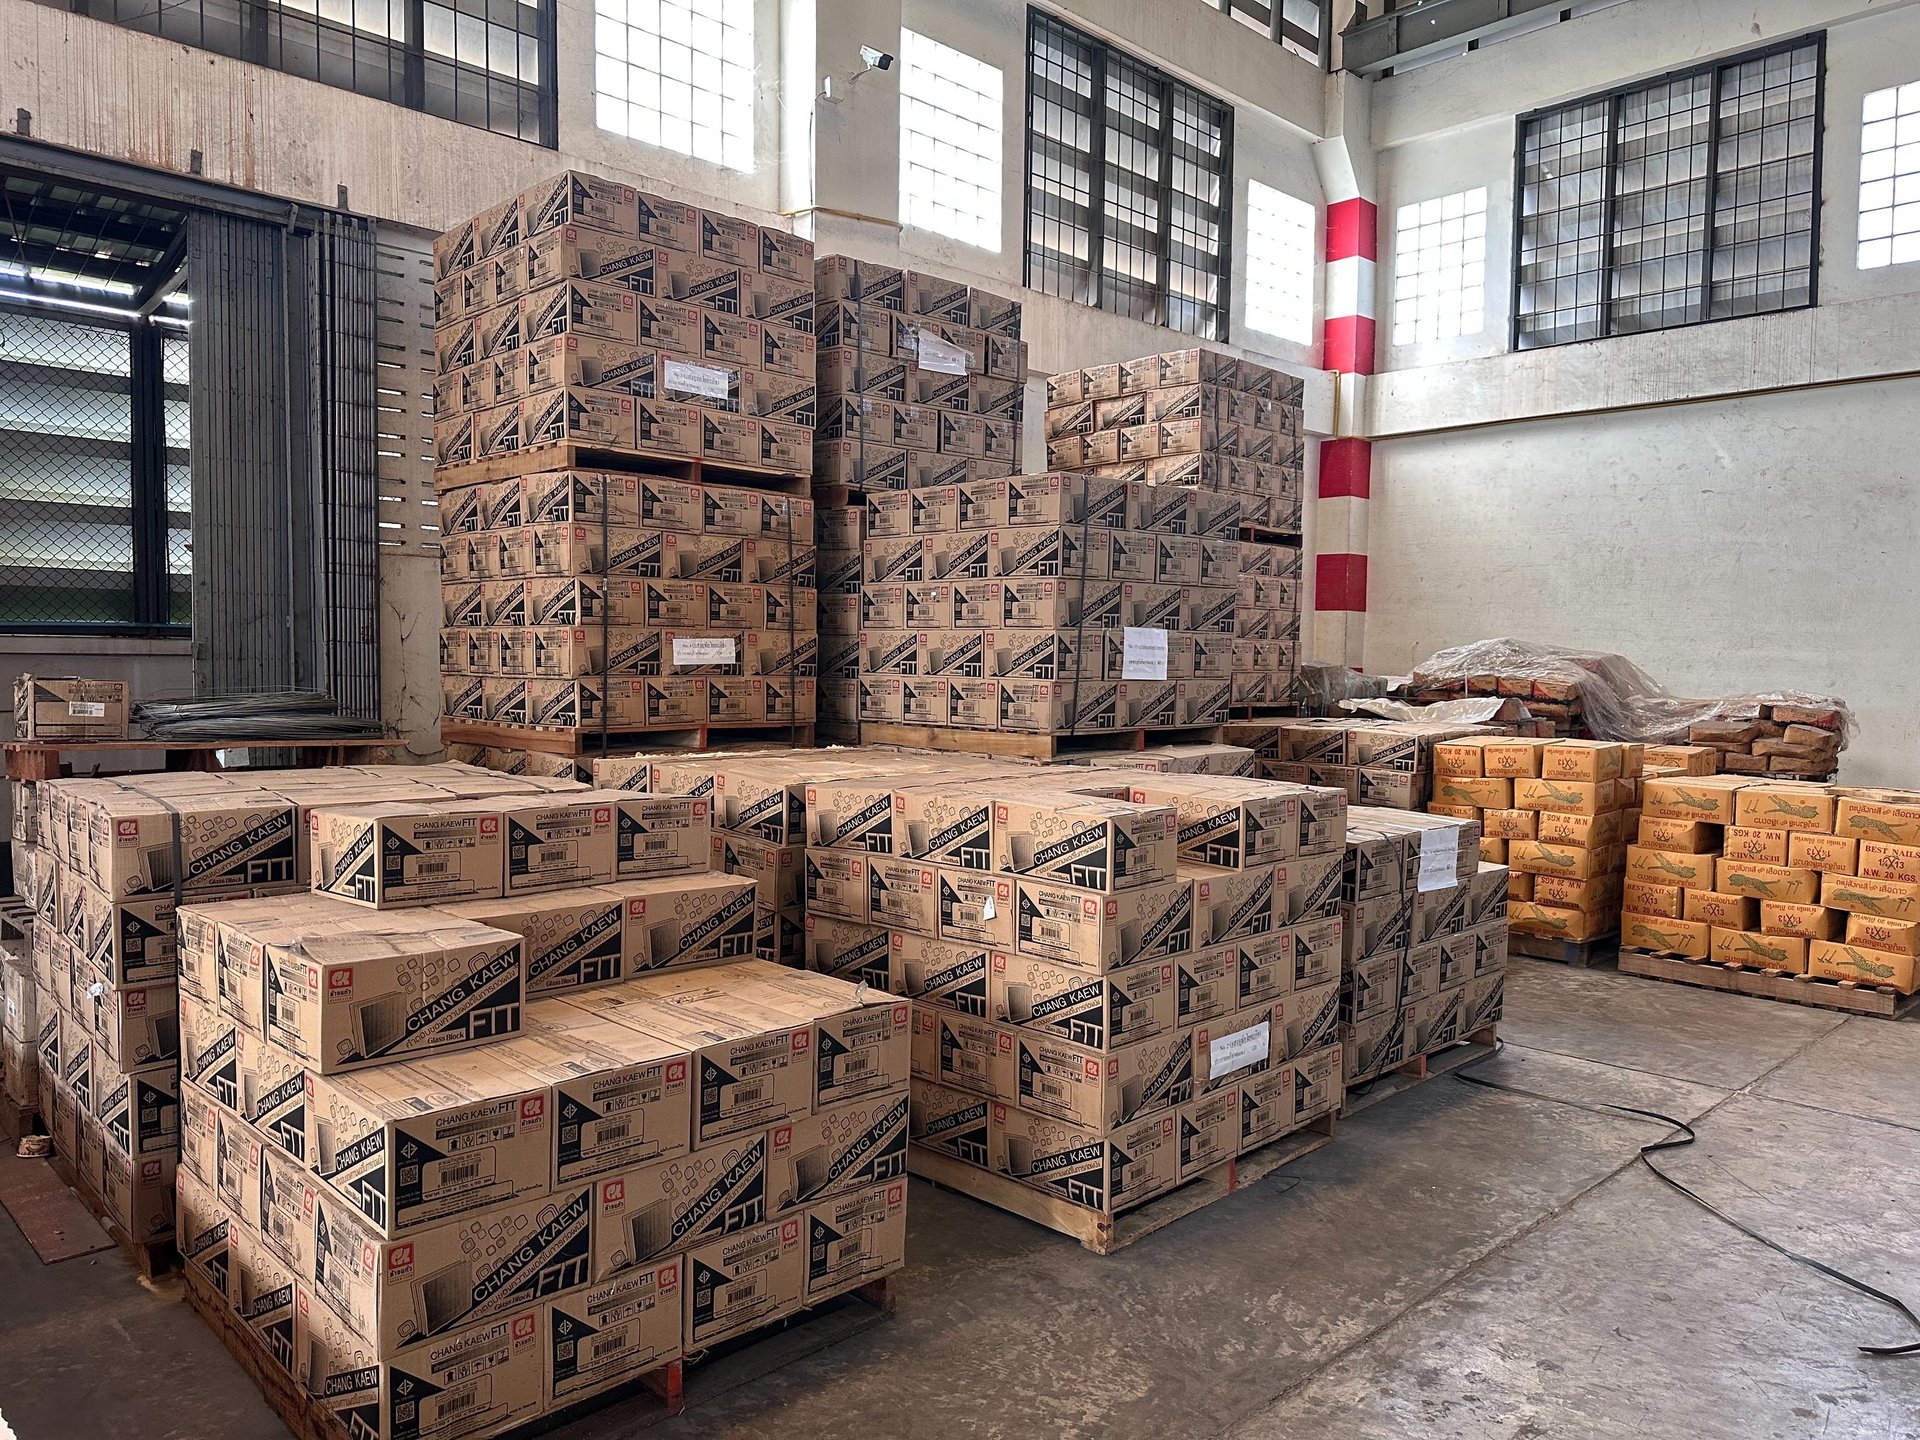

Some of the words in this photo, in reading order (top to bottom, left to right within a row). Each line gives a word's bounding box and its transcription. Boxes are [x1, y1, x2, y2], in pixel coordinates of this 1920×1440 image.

[600, 259, 628, 275] CHANG
[629, 252, 652, 266] KAEW
[629, 275, 653, 295] FIT
[689, 281, 714, 296] CHANG
[715, 273, 736, 287] KAEW
[715, 296, 737, 314] FIT
[770, 301, 793, 315] CHANG
[794, 294, 813, 307] KAEW
[793, 315, 813, 333] FIT
[602, 366, 630, 381] CHANG
[630, 356, 652, 370] KAEW
[772, 397, 795, 411] CHANG
[795, 390, 814, 402] KAEW
[795, 410, 815, 427] FIT
[611, 550, 638, 566] CHANG
[638, 536, 660, 552] KAEW
[949, 553, 969, 570] CHANG
[970, 539, 986, 554] KAEW
[1016, 550, 1038, 567] CHANG
[1038, 535, 1058, 551] KAEW
[638, 562, 661, 577] FIT
[969, 564, 988, 578] FIT
[1038, 561, 1058, 576] FIT
[1011, 652, 1033, 669] CHANG
[1034, 638, 1053, 653] KAEW
[1033, 664, 1054, 679] FIT
[1452, 748, 1461, 756] 20
[738, 807, 759, 823] CHANG
[760, 794, 781, 812] KAEW
[837, 817, 864, 837] CHANG
[865, 799, 889, 819] KAEW
[1430, 805, 1445, 813] BEST
[1447, 807, 1468, 815] NAILS
[1563, 814, 1571, 824] 20
[413, 821, 440, 830] CHANG
[440, 819, 461, 828] KAEW
[462, 818, 477, 827] FIT
[760, 824, 783, 845] FIT
[930, 830, 958, 850] CHANG
[960, 811, 986, 832] KAEW
[1751, 830, 1761, 839] 20
[190, 840, 243, 875] CHANG
[246, 814, 288, 843] KAEW
[335, 852, 354, 878] CHANG
[354, 829, 373, 854] KAEW
[865, 833, 892, 853] FIT
[1035, 844, 1069, 865] CHANG
[1072, 826, 1104, 848] KAEW
[1207, 843, 1239, 868] FIT
[1730, 851, 1754, 860] NAILS
[1865, 845, 1889, 855] BEST
[1892, 848, 1920, 858] NAILS
[248, 857, 293, 882] FIT
[960, 847, 990, 870] FIT
[1757, 854, 1781, 863] BEST
[356, 875, 375, 902] FIT
[1071, 864, 1106, 890] FIT
[1863, 868, 1880, 877] N.W.
[1885, 871, 1894, 880] 20
[1898, 874, 1918, 884] KGS.
[1626, 883, 1645, 892] BEST
[1648, 887, 1671, 896] NAILS
[680, 916, 719, 950] CHANG
[721, 893, 753, 918] KAEW
[1141, 917, 1169, 947] CHANG
[1170, 890, 1191, 918] KAEW
[1251, 912, 1271, 933] FIT
[1642, 906, 1650, 914] 20
[530, 939, 577, 976] CHANG
[581, 909, 618, 944] KAEW
[719, 932, 753, 958] FIT
[1168, 930, 1191, 953] FIT
[580, 954, 622, 984] FIT
[925, 971, 954, 991] CHANG
[956, 958, 983, 978] KAEW
[407, 989, 466, 1031] CHANG
[469, 951, 517, 989] KAEW
[1032, 997, 1067, 1018] CHANG
[1069, 985, 1100, 1004] KAEW
[956, 993, 986, 1018] FIT
[469, 1003, 519, 1040] FIT
[1069, 1018, 1102, 1049] FIT
[428, 1034, 445, 1044] Glass
[446, 1031, 465, 1041] Block
[730, 1044, 755, 1055] CHANG
[755, 1039, 776, 1051] KAEW
[776, 1034, 789, 1045] FIT
[593, 1076, 621, 1089] CHANG
[622, 1072, 646, 1084] KAEW
[646, 1065, 662, 1078] FIT
[257, 1091, 280, 1116] CHANG
[280, 1076, 303, 1099] KAEW
[436, 1112, 469, 1127] CHANG
[470, 1107, 498, 1120] KAEW
[498, 1100, 517, 1114] FIT
[926, 1117, 955, 1135] CHANG
[957, 1106, 984, 1123] KAEW
[280, 1121, 304, 1161] FIT
[335, 1148, 359, 1171] CHANG
[360, 1132, 383, 1157] KAEW
[829, 1138, 871, 1179] CHANG
[873, 1102, 907, 1139] KAEW
[957, 1137, 987, 1166] FIT
[872, 1149, 907, 1183] FIT
[1031, 1153, 1067, 1173] CHANG
[1069, 1145, 1100, 1162] KAEW
[672, 1187, 722, 1237] CHANG
[724, 1146, 763, 1187] KAEW
[1068, 1178, 1102, 1210] FIT
[362, 1180, 385, 1230] FIT
[723, 1196, 766, 1235] FIT
[474, 1246, 535, 1301] CHANG
[538, 1199, 584, 1246] KAEW
[536, 1253, 588, 1298] FIT
[431, 1342, 463, 1360] CHANG
[464, 1331, 491, 1348] KAEW
[490, 1322, 509, 1339] FIT
[325, 1377, 353, 1395] CHANG
[355, 1369, 377, 1387] KAEW
